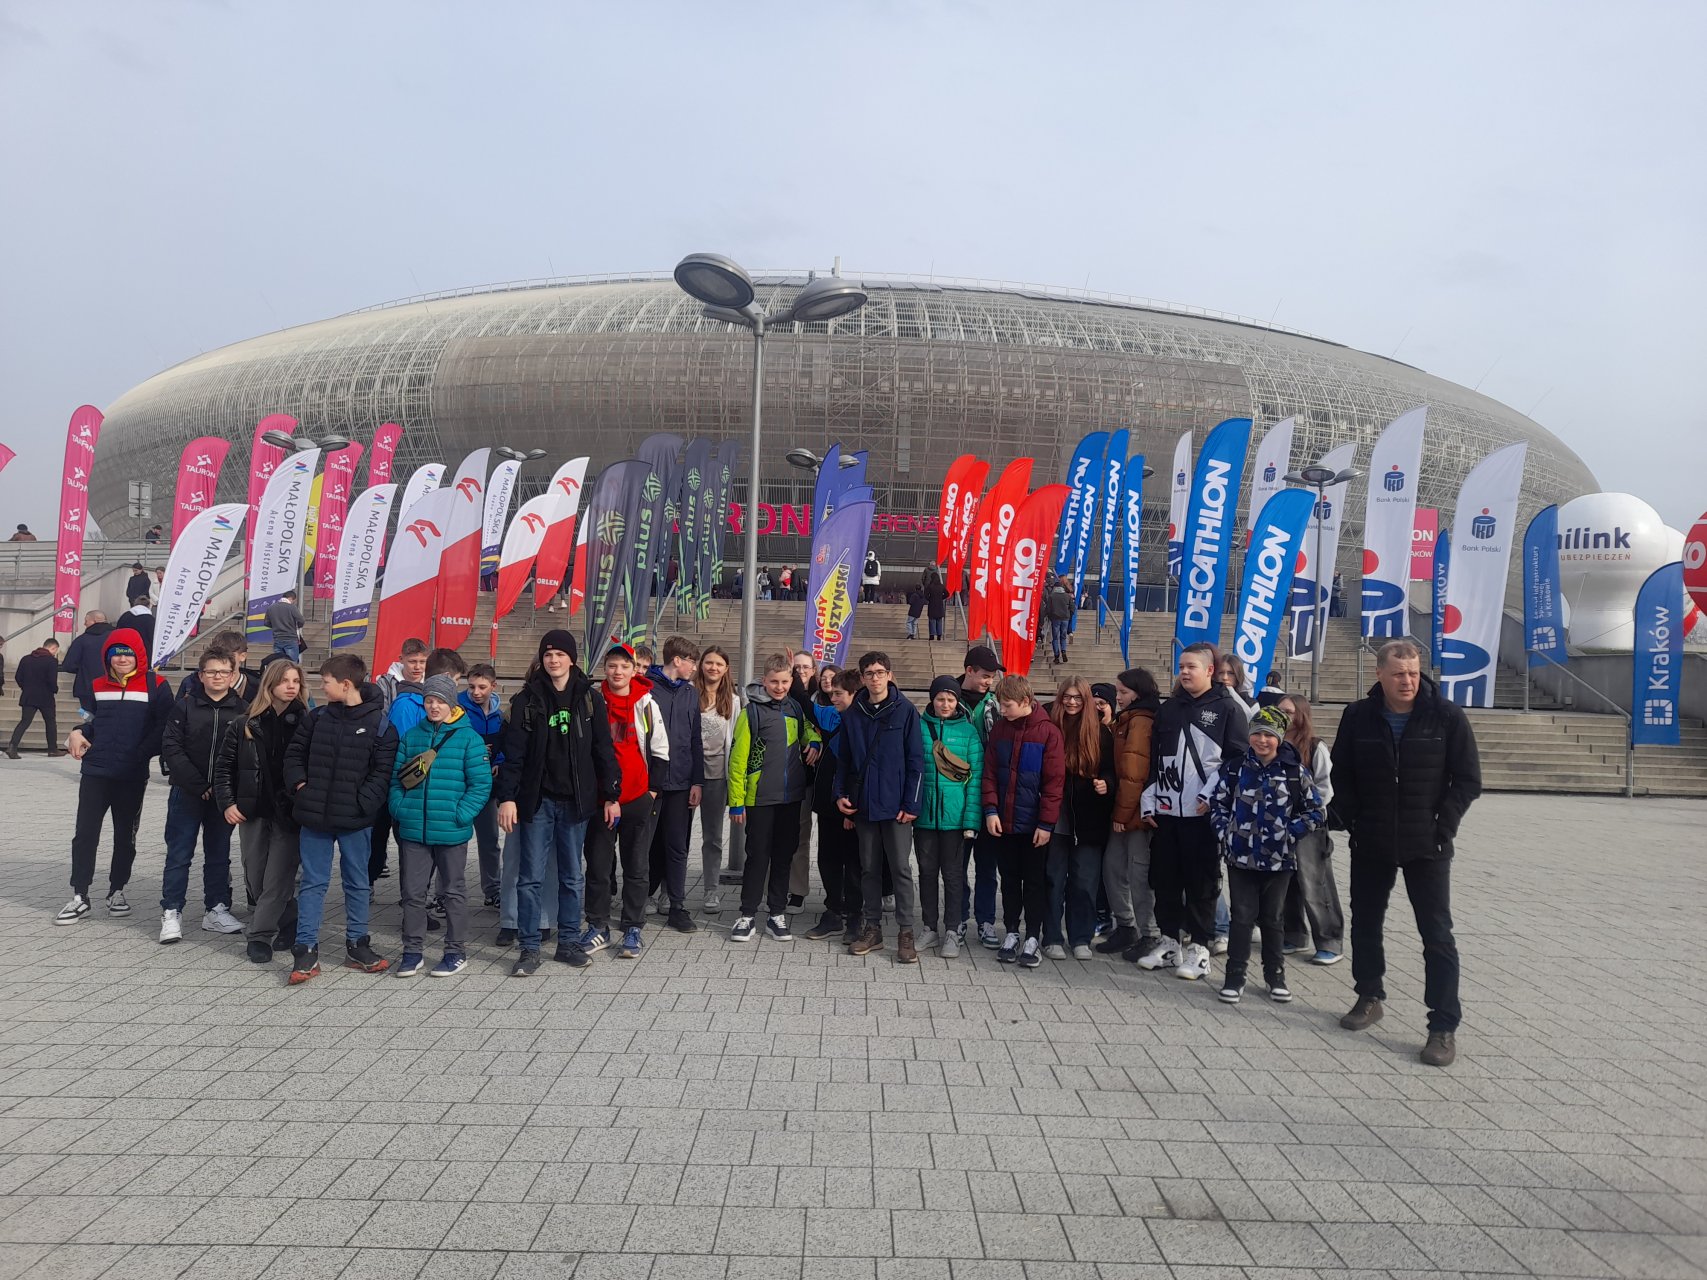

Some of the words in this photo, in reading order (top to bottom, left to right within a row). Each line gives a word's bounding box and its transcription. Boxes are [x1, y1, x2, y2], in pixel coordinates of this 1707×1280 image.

[185, 464, 216, 479] TAURON
[255, 470, 271, 480] TAUR
[180, 502, 207, 513] TAUR
[266, 510, 279, 536] Arena
[277, 481, 302, 574] MAŁOPOLSKA
[685, 494, 697, 543] plus
[871, 513, 939, 533] RENA
[943, 482, 959, 538] AL-KO
[348, 534, 359, 556] Arena
[355, 509, 380, 590] MAŁOPOLSKA
[634, 508, 652, 570] plus
[701, 513, 711, 556] plus
[1038, 543, 1048, 567] LIFE
[1183, 458, 1232, 630] DECATHLON
[1410, 549, 1433, 558] AKÓW
[1558, 527, 1631, 550] ilink
[1560, 551, 1631, 561] UBEZPIECZEŃ
[174, 566, 191, 596] Arena
[260, 542, 274, 593] Mistrzostw
[342, 561, 354, 604] Mistrzostw
[536, 578, 559, 586] ORLEN
[592, 554, 615, 625] plus
[1010, 538, 1037, 641] AL-KO
[1236, 524, 1291, 691] ECATHLON
[440, 616, 471, 626] ORLEN
[812, 594, 828, 661] BLACHY
[1648, 605, 1670, 691] Kraków
